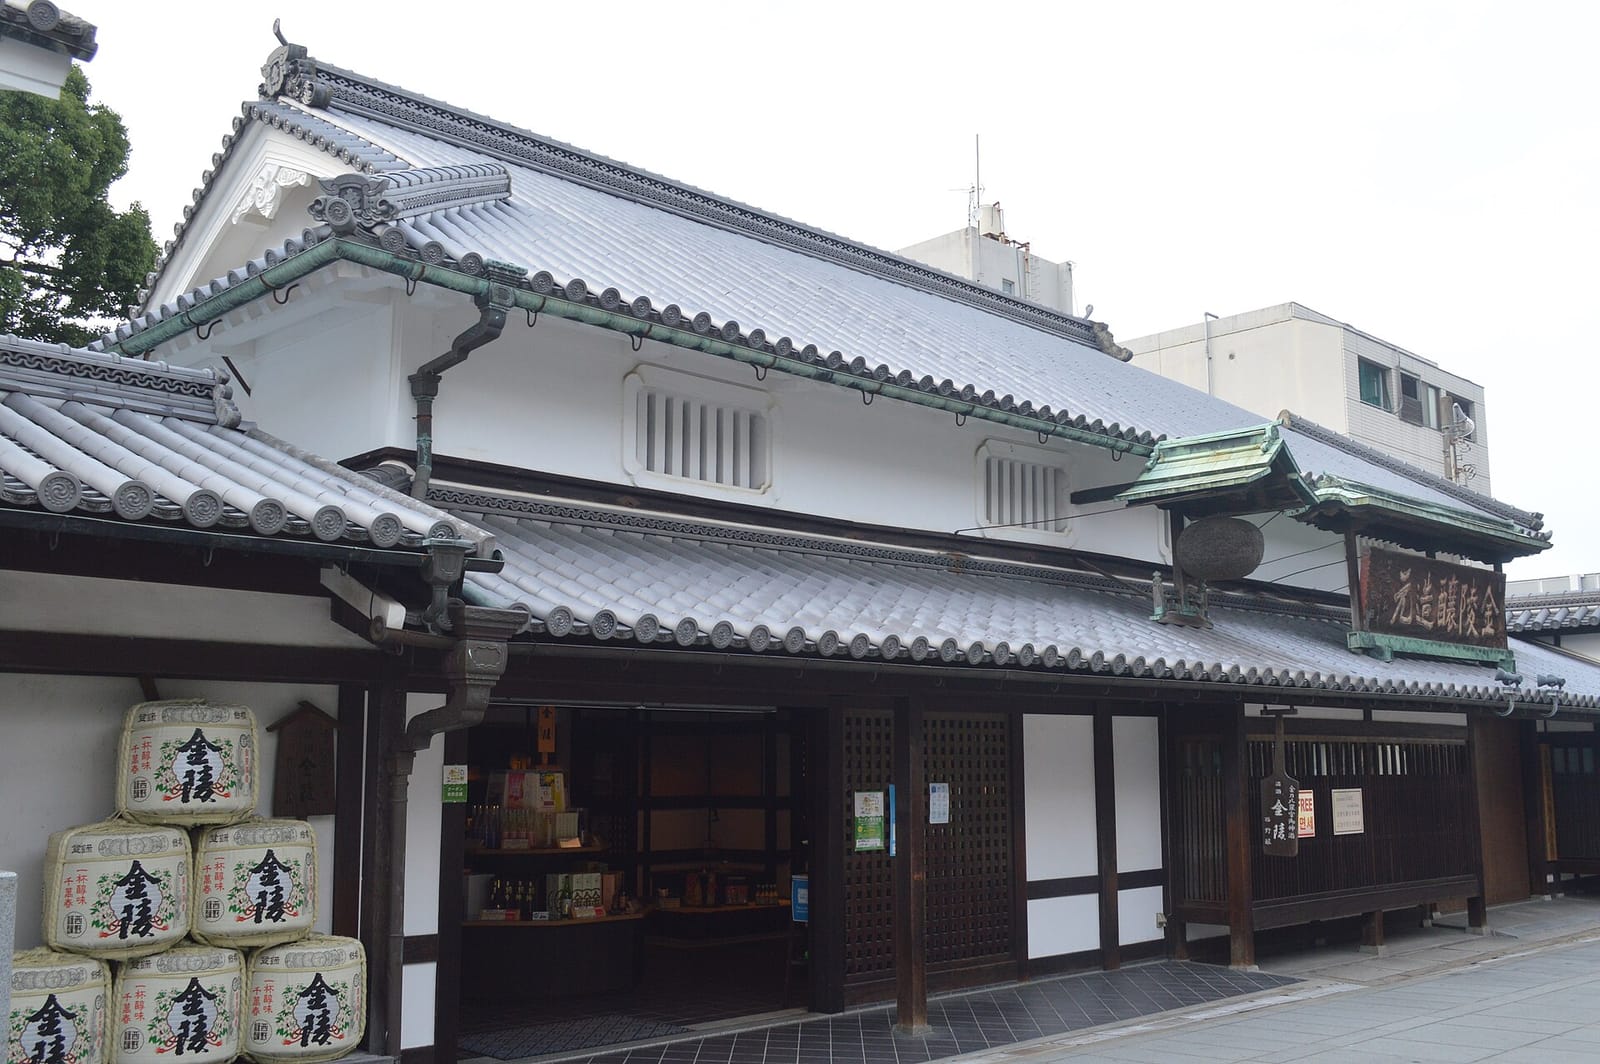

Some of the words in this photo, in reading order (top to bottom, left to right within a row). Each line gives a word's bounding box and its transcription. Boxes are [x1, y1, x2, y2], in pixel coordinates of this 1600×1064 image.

[175, 728, 222, 803] 金陵
[1271, 799, 1288, 840] 金陵
[113, 859, 162, 939] 金陵
[248, 849, 292, 924] 金陵
[171, 977, 217, 1055] 金陵
[299, 972, 340, 1047] 金陵
